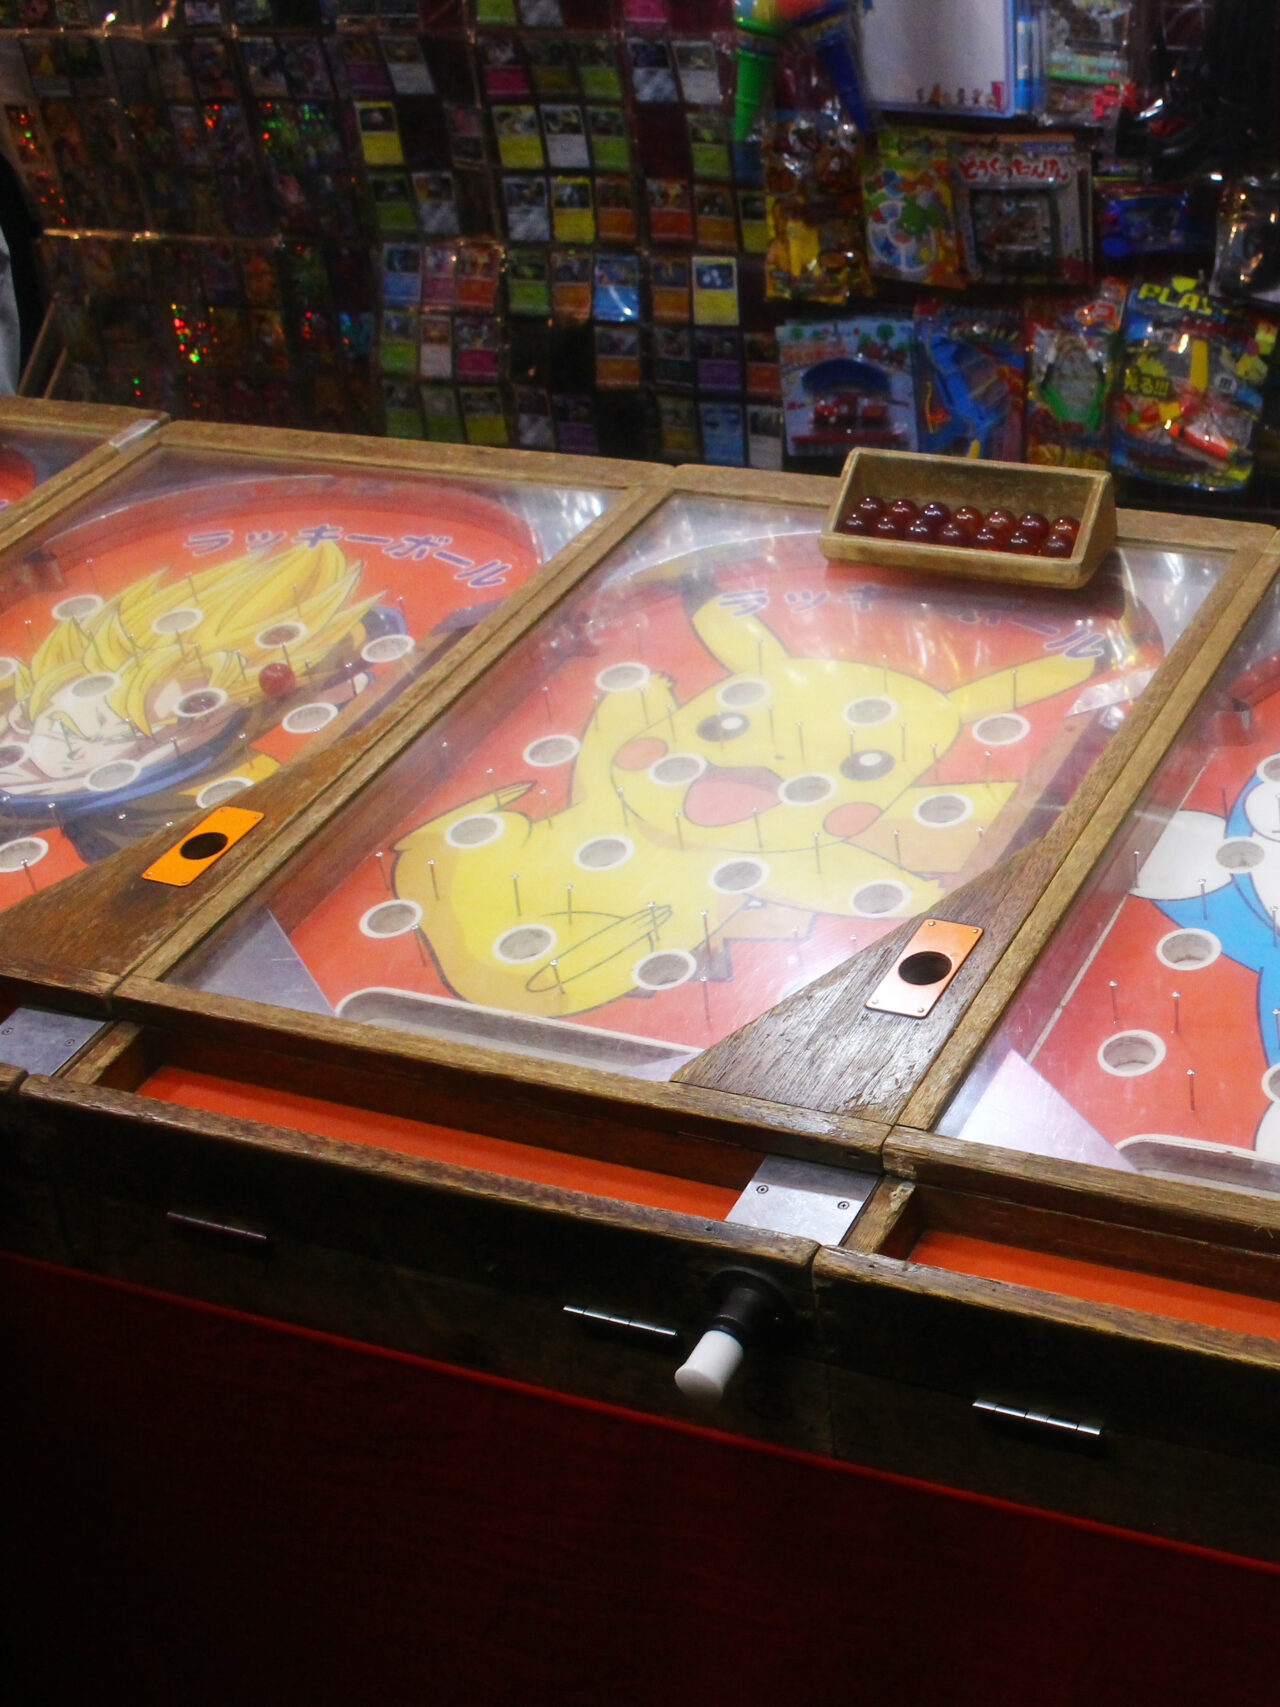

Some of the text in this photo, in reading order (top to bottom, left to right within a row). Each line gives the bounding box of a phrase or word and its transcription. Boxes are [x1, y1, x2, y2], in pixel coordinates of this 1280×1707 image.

[957, 154, 1070, 181] どうくつたんけん
[183, 523, 511, 589] ラッキーボール
[717, 583, 1105, 660] ラッキール
